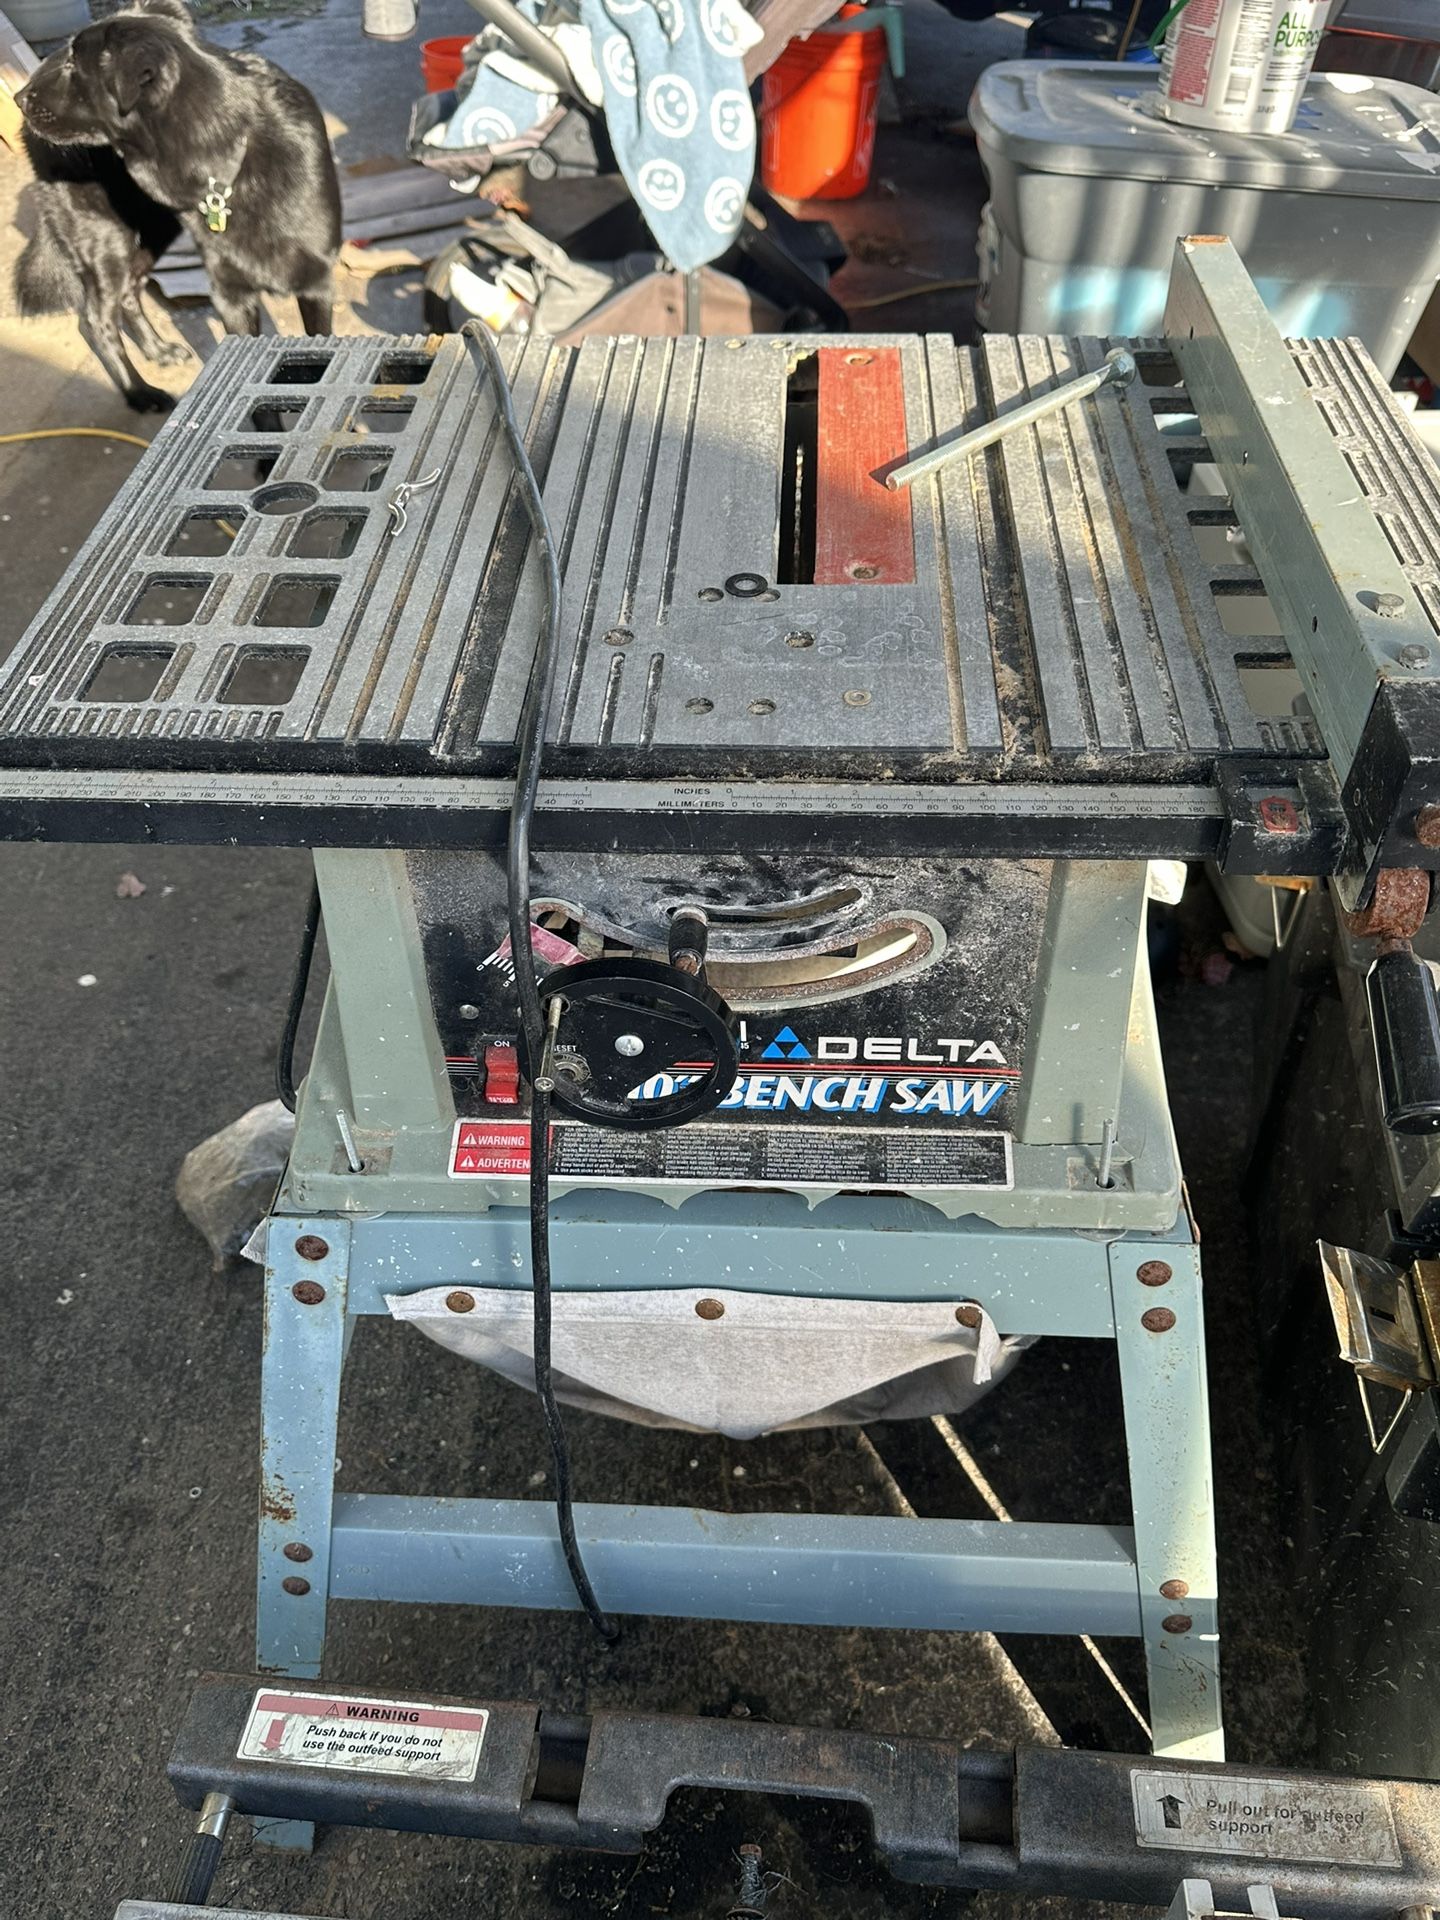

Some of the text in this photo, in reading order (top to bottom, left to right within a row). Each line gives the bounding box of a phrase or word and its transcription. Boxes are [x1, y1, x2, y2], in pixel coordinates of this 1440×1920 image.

[1278, 11, 1306, 29] ALL
[658, 800, 725, 808] MILLIMETERS
[494, 1040, 511, 1048] ON
[817, 1036, 1007, 1064] DELTA
[717, 1075, 887, 1112] BENCH
[890, 1078, 1009, 1116] SAW
[478, 1135, 526, 1146] WARNING
[477, 1158, 531, 1170] ADVERTEN
[346, 1705, 420, 1723] WARNING
[306, 1724, 443, 1748] Push back if you do not
[302, 1739, 441, 1762] use the outfeed support
[1206, 1800, 1237, 1814] Pull
[1242, 1804, 1270, 1817] out
[1274, 1806, 1296, 1820] for
[1208, 1818, 1273, 1836] support
